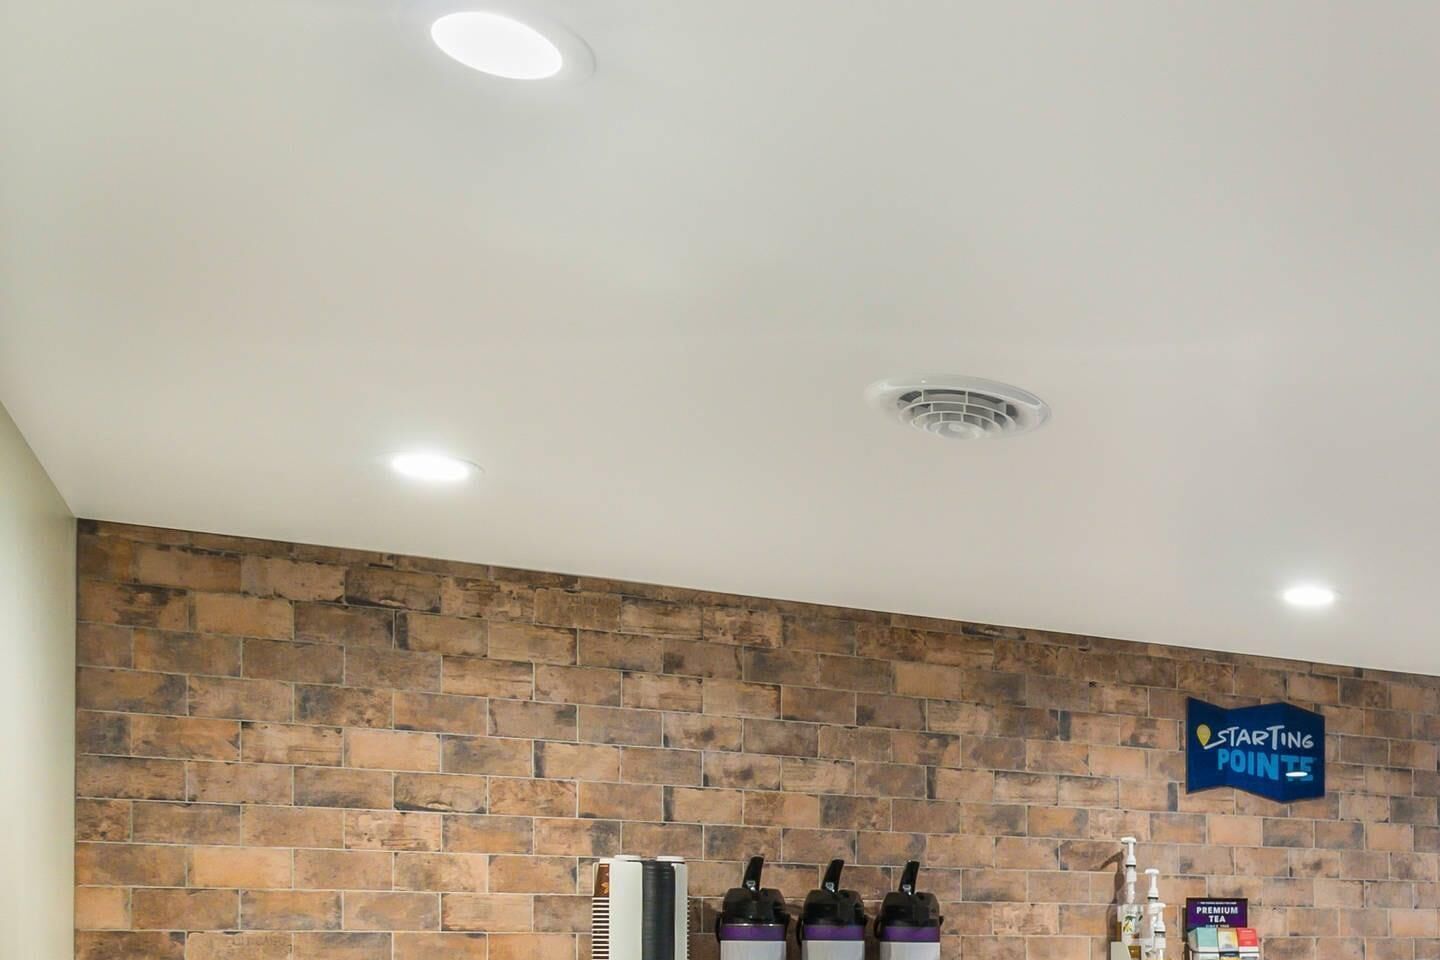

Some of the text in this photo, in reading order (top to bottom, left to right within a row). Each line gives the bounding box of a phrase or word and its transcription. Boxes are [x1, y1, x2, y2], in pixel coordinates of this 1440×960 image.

[1204, 725, 1314, 750] STARTING
[1217, 748, 1314, 782] POINTE
[1196, 906, 1239, 914] PREMIUM
[1208, 915, 1226, 923] TEA
